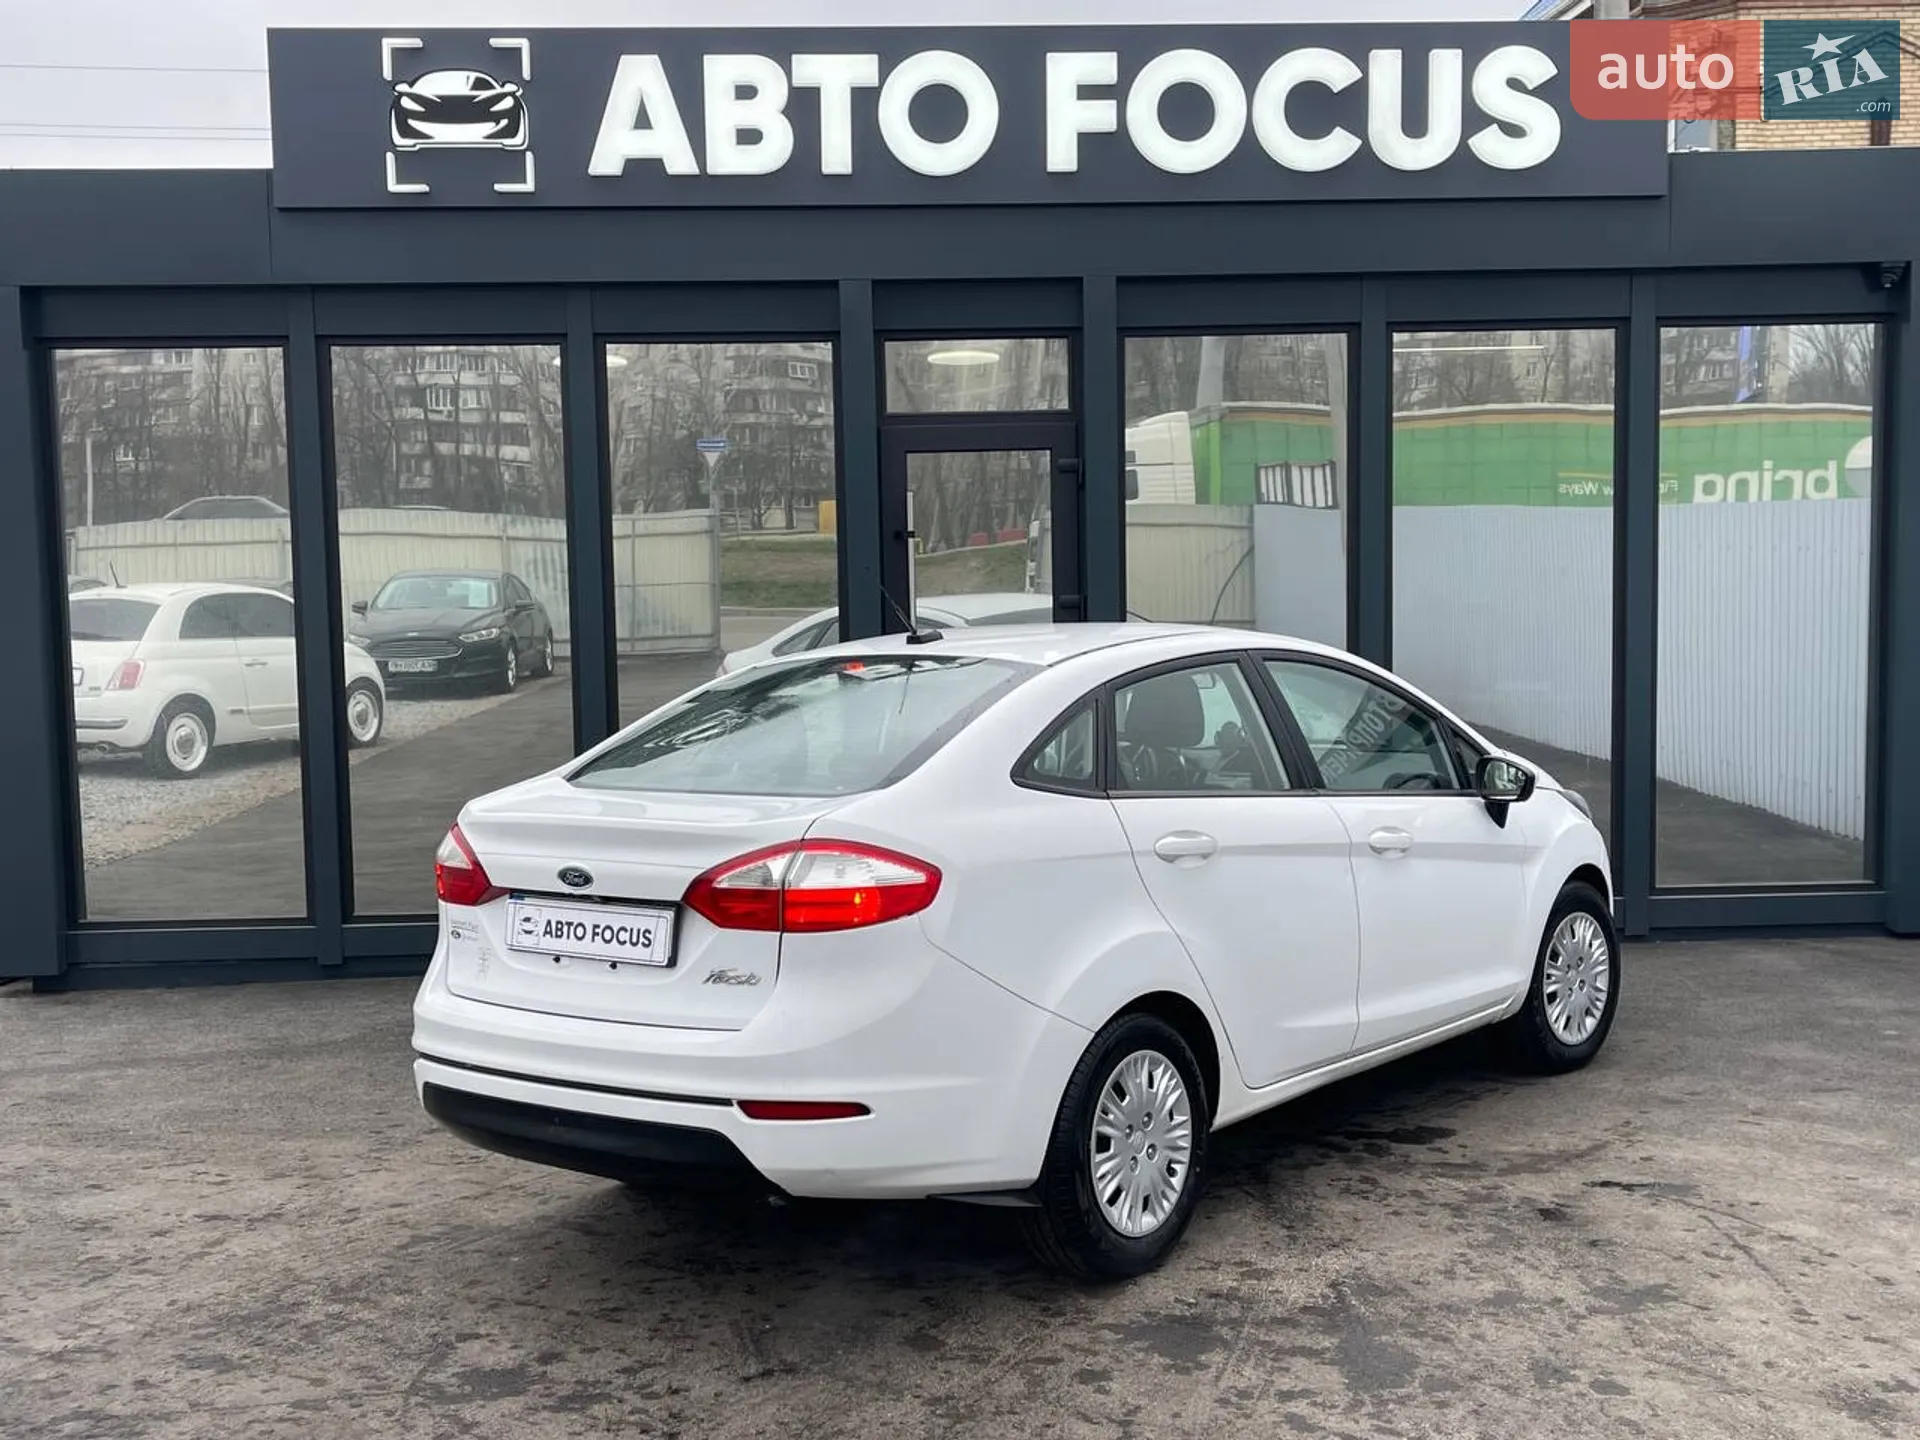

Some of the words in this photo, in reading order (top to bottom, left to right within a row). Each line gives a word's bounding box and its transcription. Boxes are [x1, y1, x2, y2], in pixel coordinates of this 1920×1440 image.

[587, 49, 999, 177] АВТО
[1046, 45, 1561, 173] FOCUS
[542, 919, 587, 941] АВТО
[591, 924, 653, 948] FOCUS
